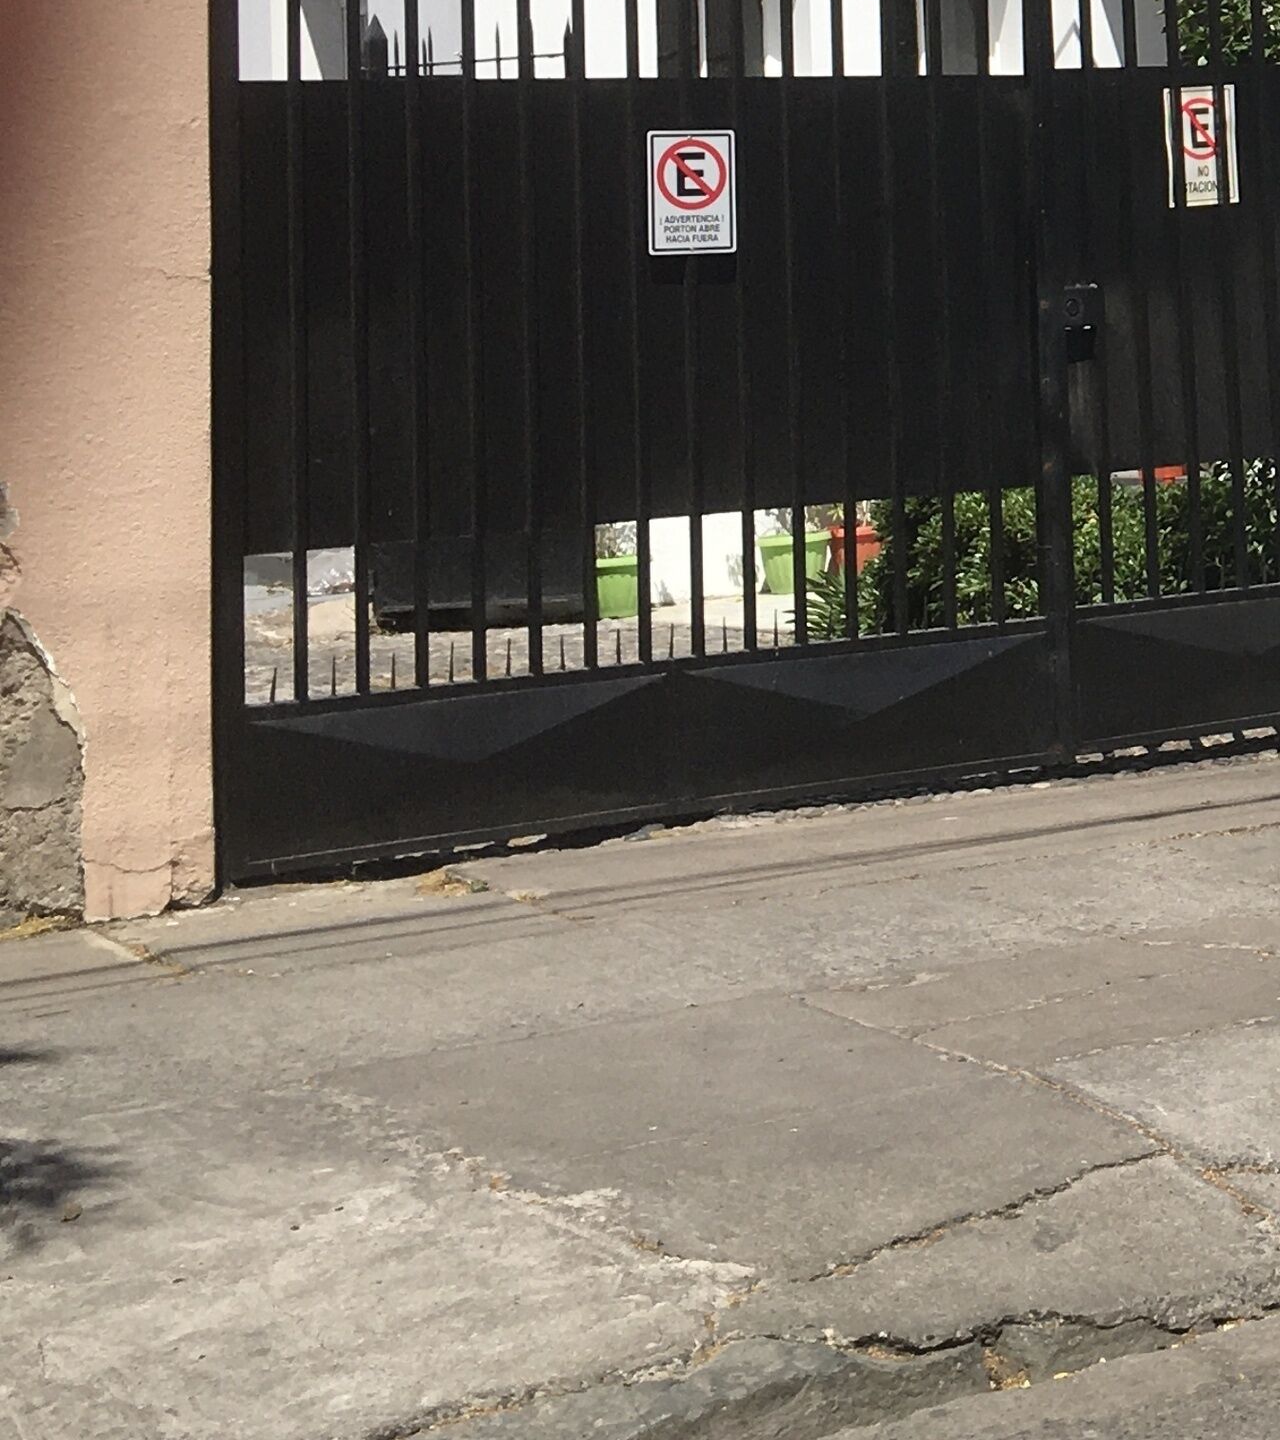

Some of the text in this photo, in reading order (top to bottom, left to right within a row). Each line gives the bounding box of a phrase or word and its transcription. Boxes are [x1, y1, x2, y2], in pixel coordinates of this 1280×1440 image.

[1189, 107, 1210, 149] E
[676, 152, 706, 197] E
[1197, 165, 1210, 177] NO
[663, 224, 721, 233] PORTON ABRE
[666, 233, 719, 243] HACIA FUERA
